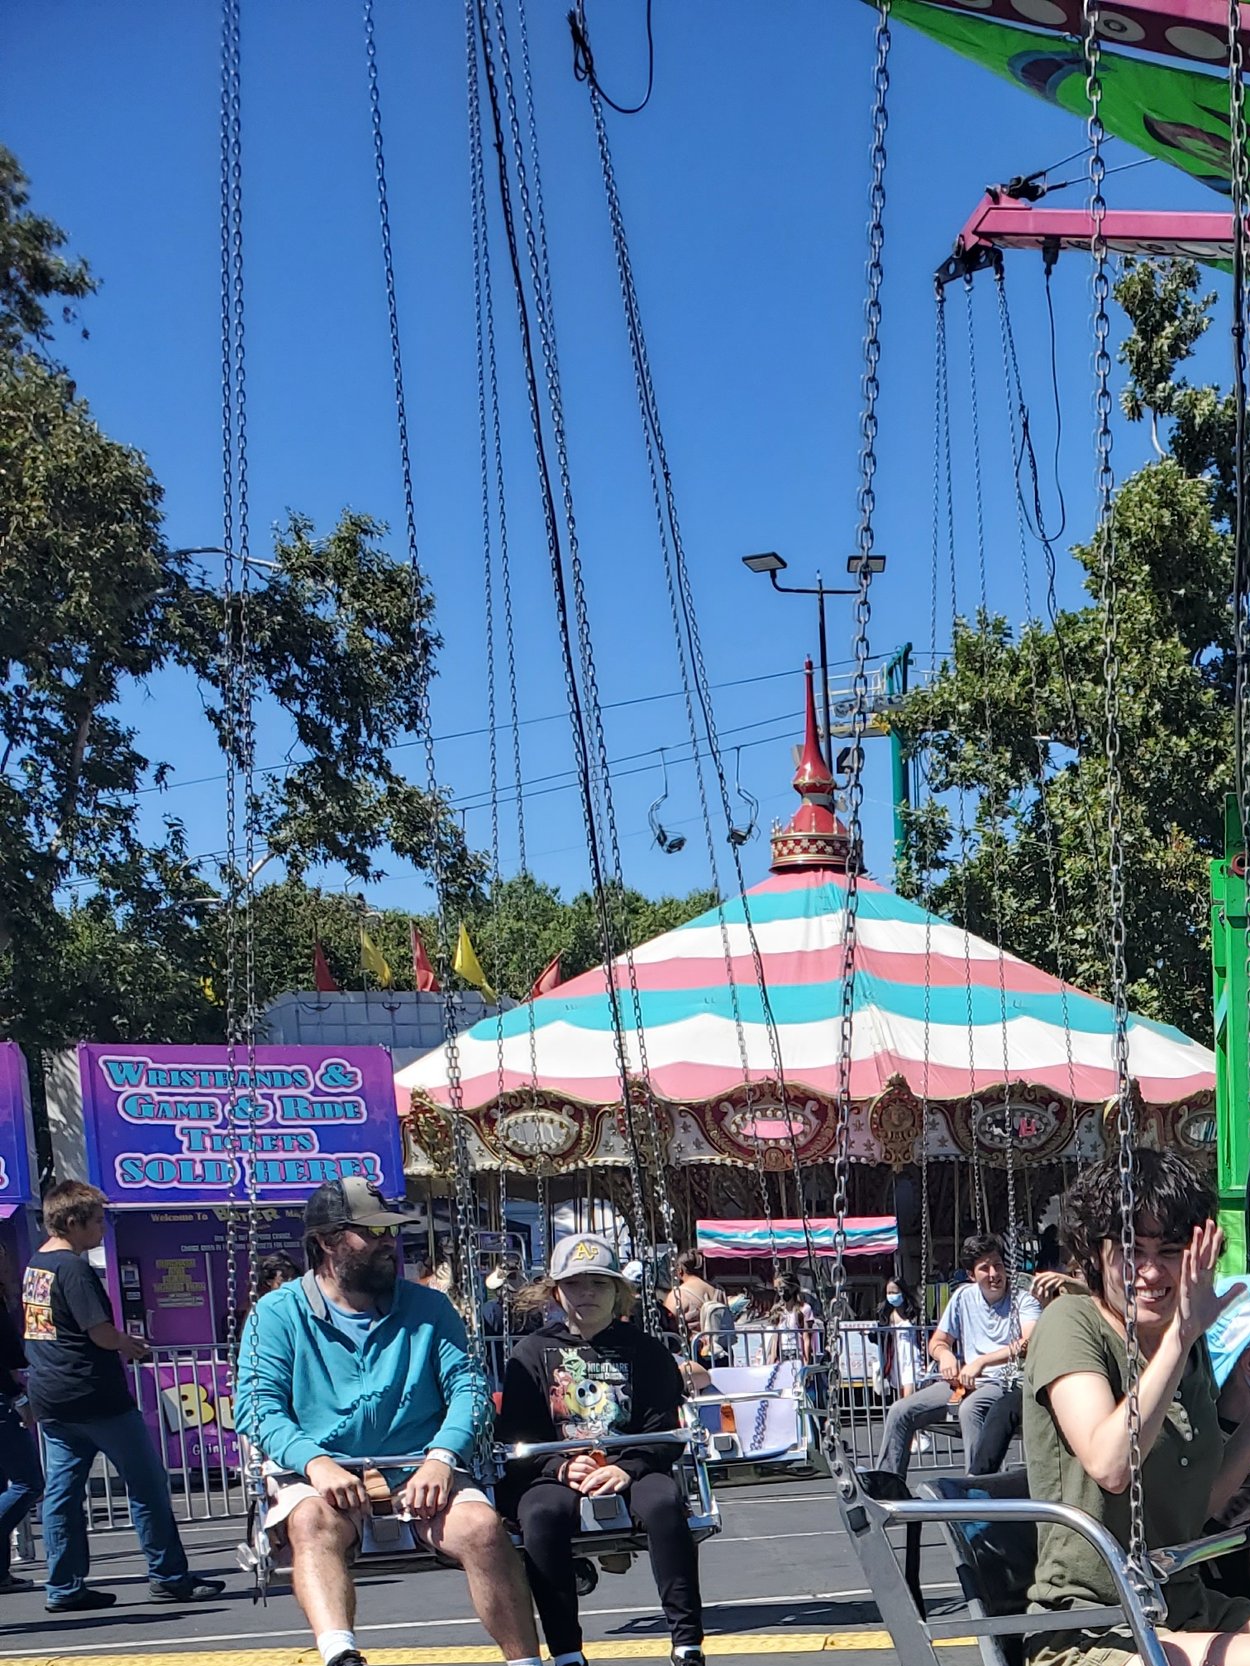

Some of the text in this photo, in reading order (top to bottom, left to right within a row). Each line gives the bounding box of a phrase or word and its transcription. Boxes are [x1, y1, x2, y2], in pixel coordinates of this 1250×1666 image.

[320, 1062, 357, 1088] &
[229, 1098, 269, 1120] &
[120, 1156, 379, 1184] SOLD HERE!
[151, 1213, 194, 1222] Welcome
[196, 1211, 209, 1221] To
[211, 1207, 282, 1222] BUTER
